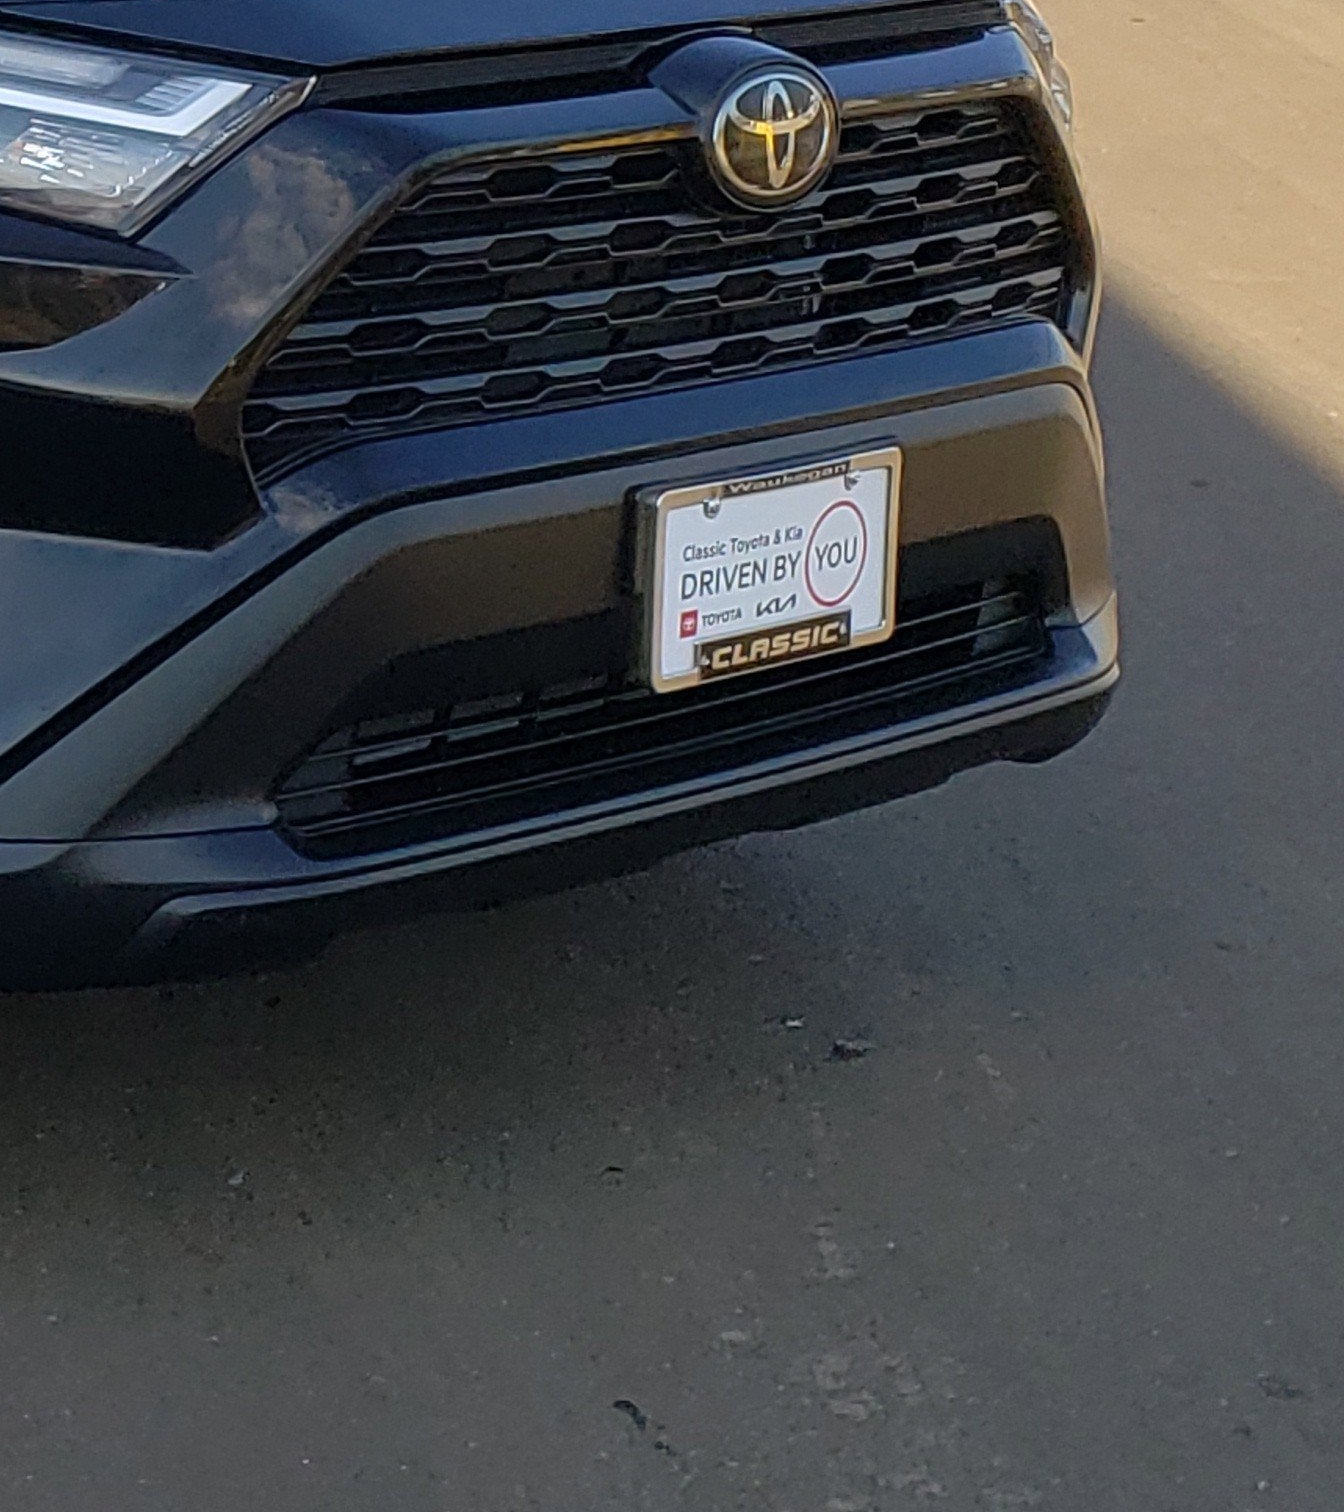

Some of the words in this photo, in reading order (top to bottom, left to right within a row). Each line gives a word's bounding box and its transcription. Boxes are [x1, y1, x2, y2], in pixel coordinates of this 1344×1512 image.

[682, 540, 727, 562] Classic
[729, 534, 770, 555] Toyota
[773, 528, 781, 545] &
[784, 525, 803, 542] Kia
[680, 558, 767, 600] DRIVEN
[773, 550, 802, 581] BY
[815, 536, 858, 571] YOU
[701, 607, 742, 627] TOYOTA
[712, 621, 841, 671] CLASSIC
